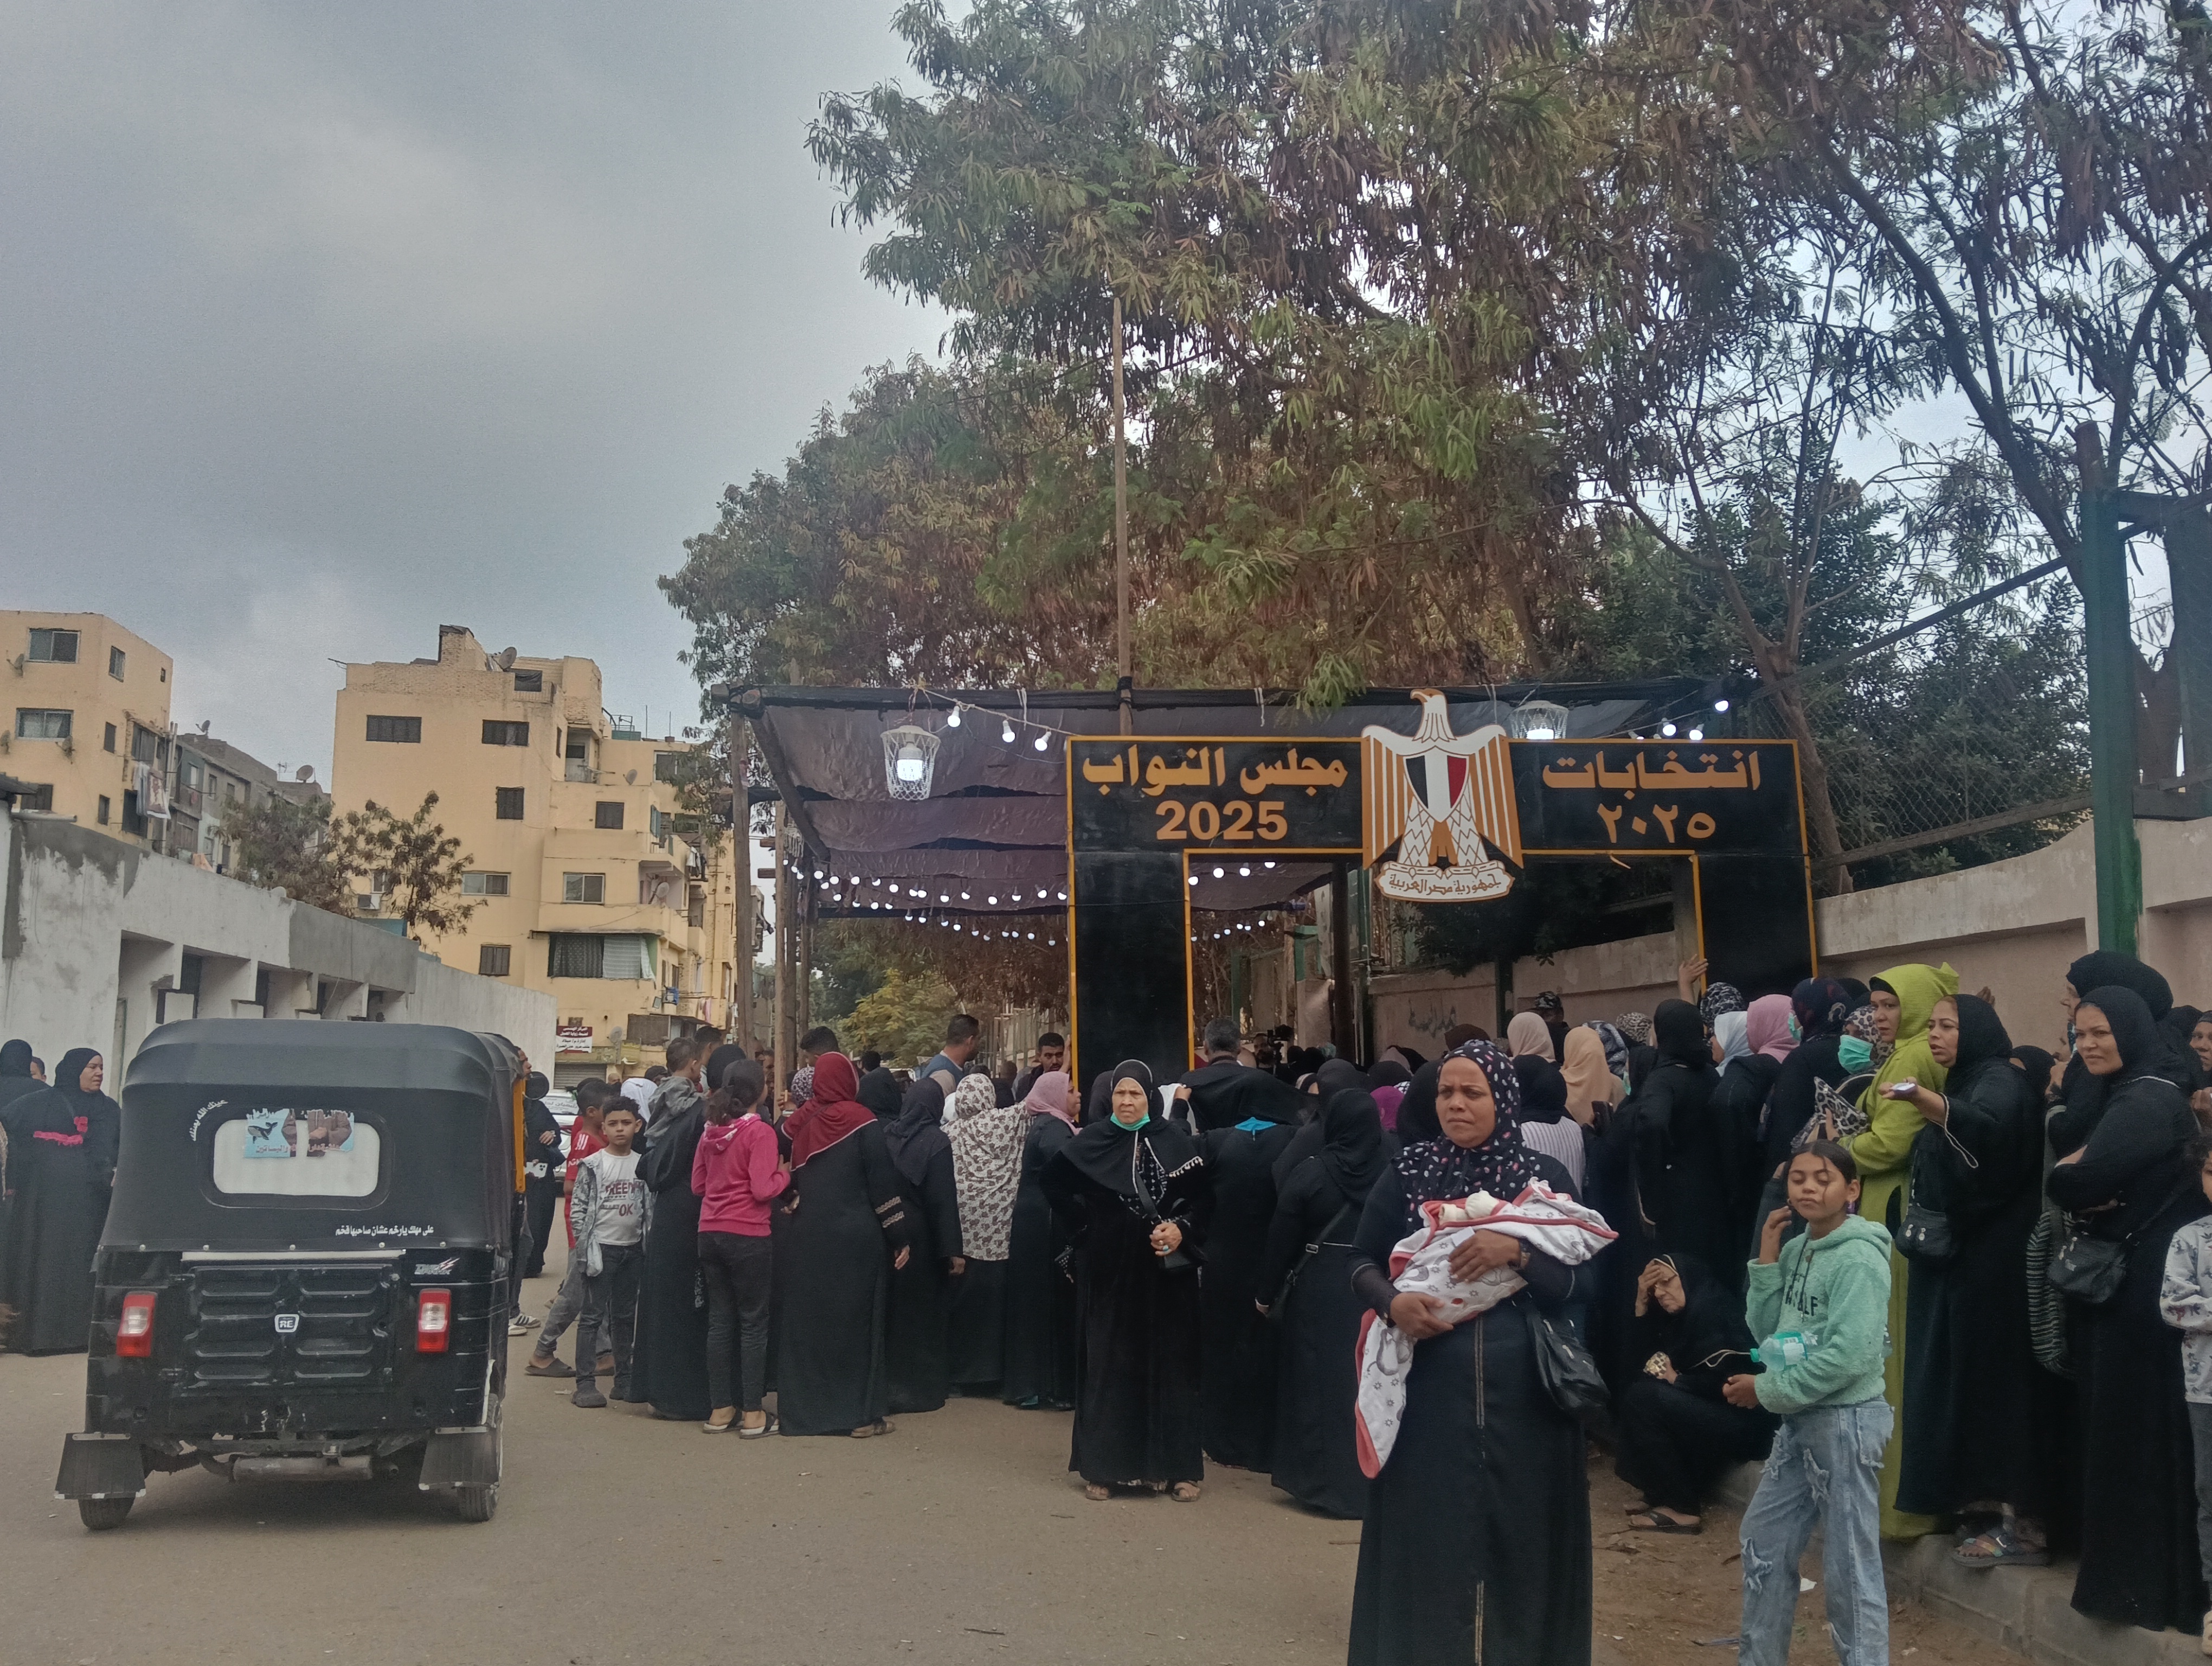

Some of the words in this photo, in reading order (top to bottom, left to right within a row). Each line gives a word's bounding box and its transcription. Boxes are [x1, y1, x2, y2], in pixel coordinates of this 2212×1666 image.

[1083, 744, 1226, 796] النواب
[1240, 748, 1348, 797] مجلس
[1542, 751, 1760, 800] انتخابات
[1155, 800, 1288, 840] 2025
[1597, 803, 1716, 843] ٢٠٢٥
[1388, 873, 1428, 894] العربية
[1426, 884, 1453, 895] مصر
[1454, 873, 1501, 895] جمهورية
[196, 1107, 209, 1120] الله
[619, 1203, 634, 1216] OK
[371, 1225, 388, 1236] عشان
[422, 1225, 434, 1236] على
[279, 1320, 294, 1328] RE
